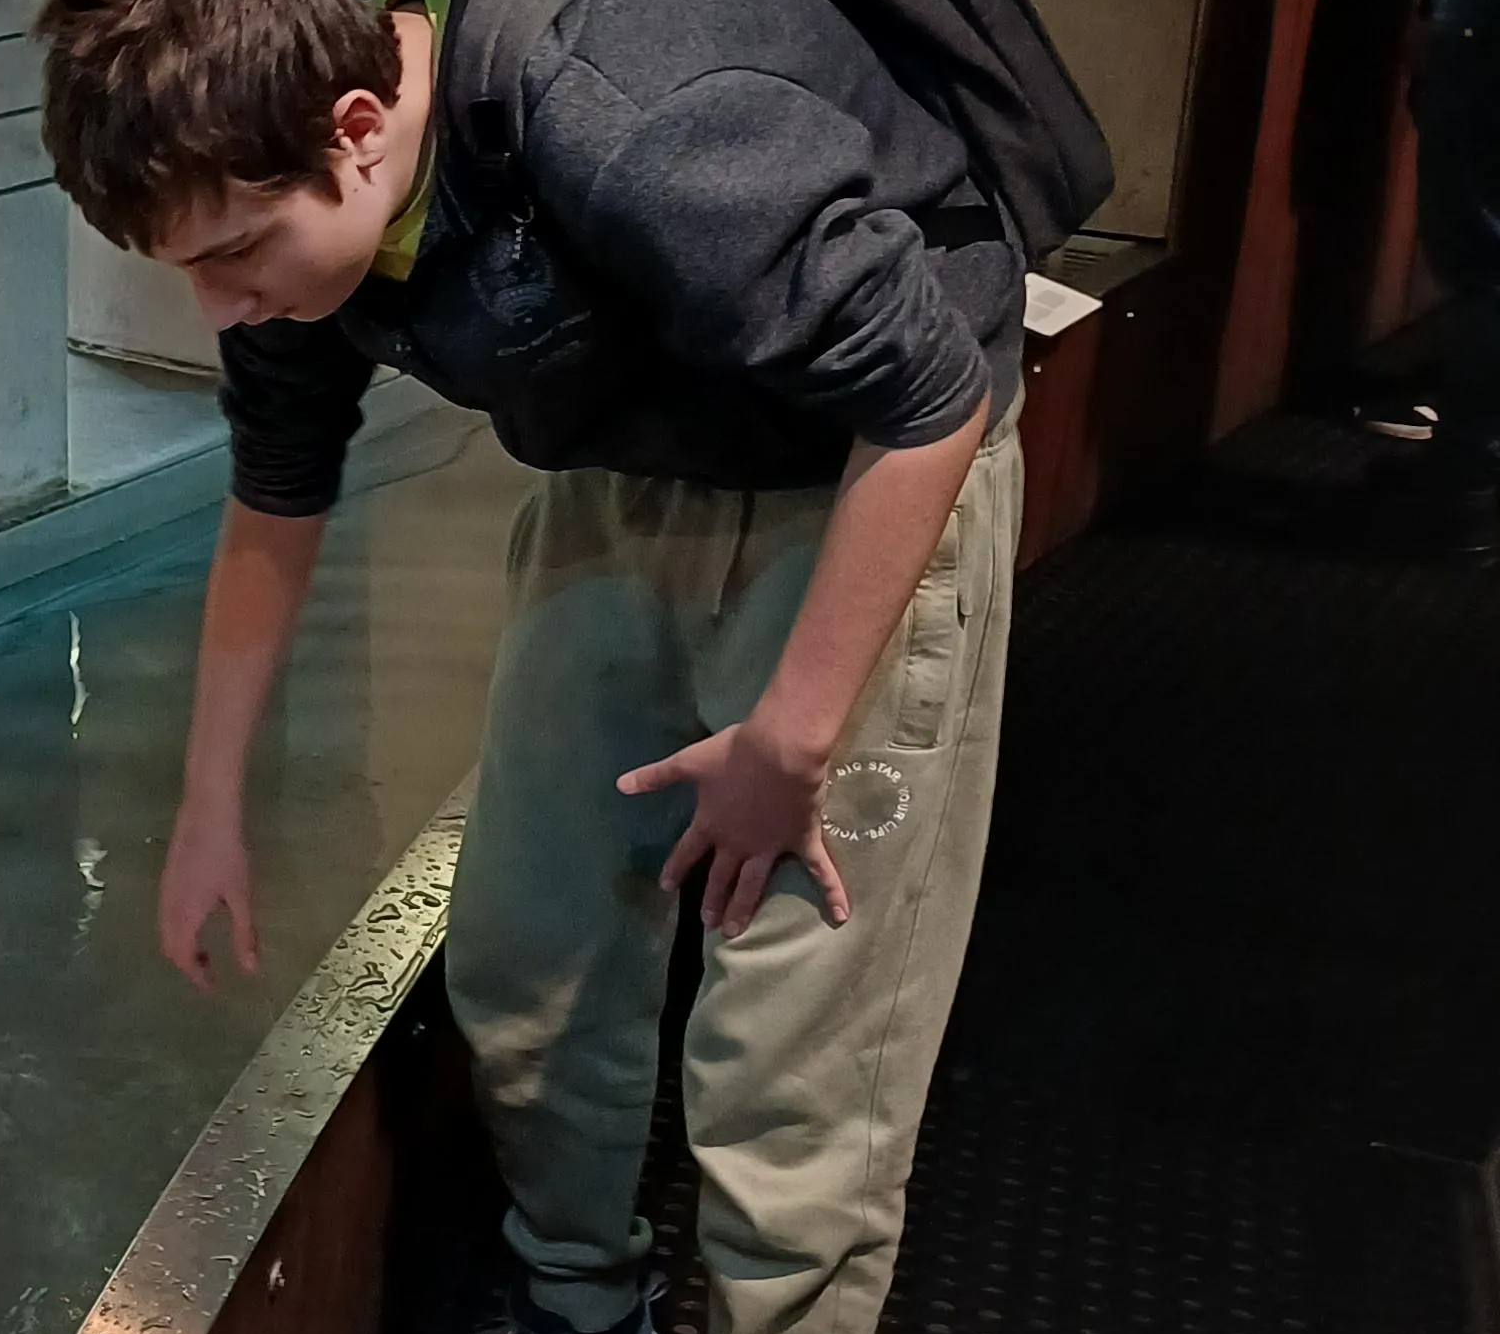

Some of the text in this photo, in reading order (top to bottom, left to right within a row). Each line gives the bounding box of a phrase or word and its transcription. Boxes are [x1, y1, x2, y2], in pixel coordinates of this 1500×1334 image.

[836, 761, 862, 777] BIG
[868, 761, 902, 784] STAR
[892, 785, 911, 821] YOUR
